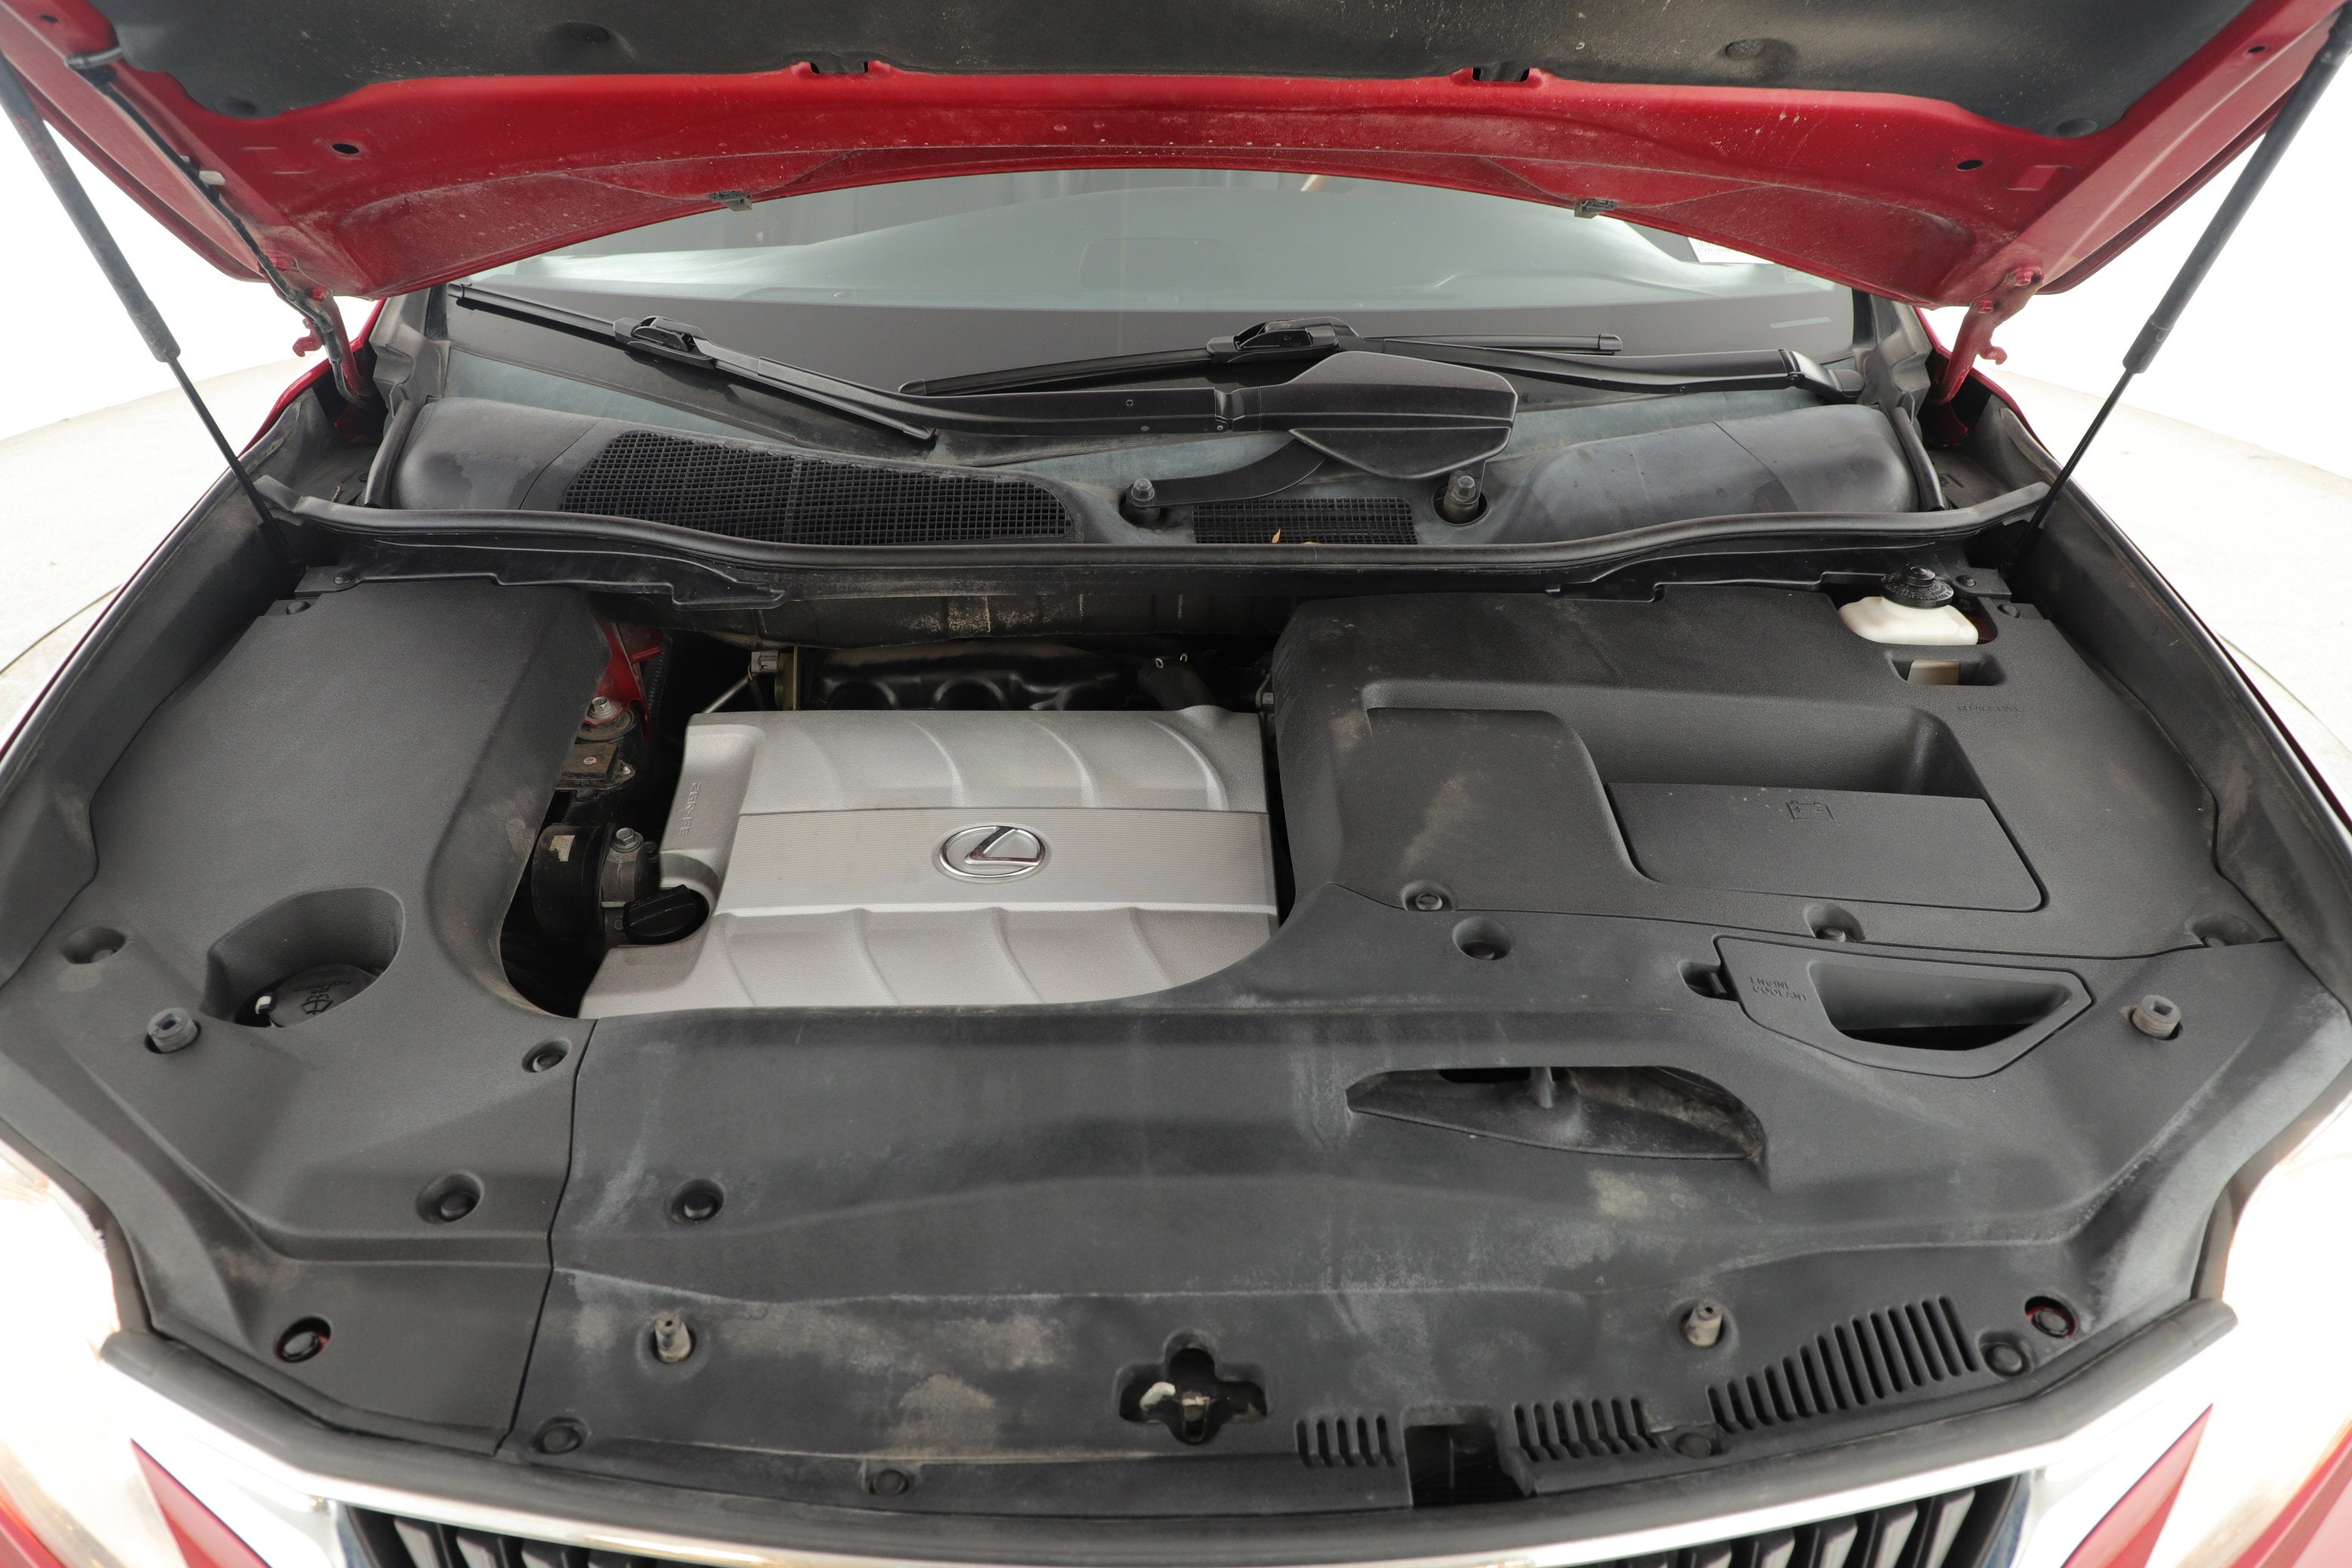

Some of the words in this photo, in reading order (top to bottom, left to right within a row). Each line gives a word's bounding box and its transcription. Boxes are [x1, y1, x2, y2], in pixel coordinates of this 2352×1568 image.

[679, 782, 701, 836] 2GR-FE
[1750, 976, 1791, 990] ENGINE
[1753, 986, 1808, 1001] COOLANT
